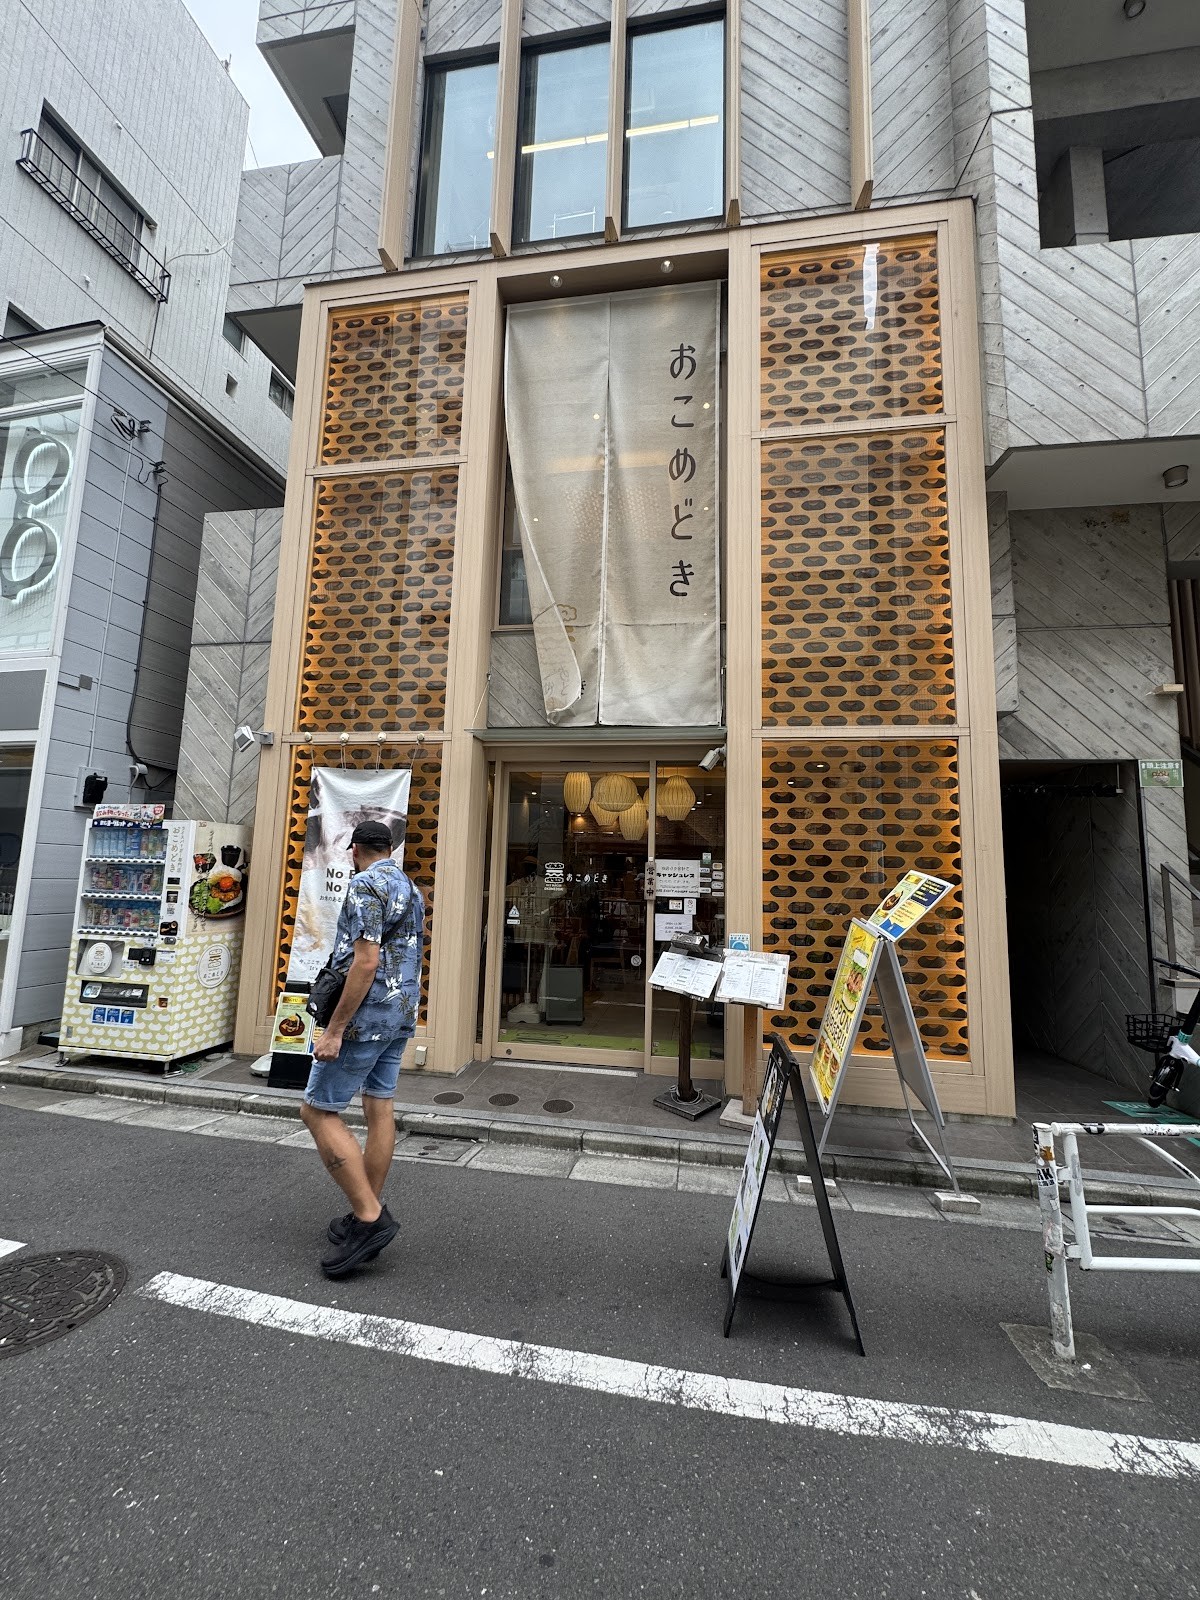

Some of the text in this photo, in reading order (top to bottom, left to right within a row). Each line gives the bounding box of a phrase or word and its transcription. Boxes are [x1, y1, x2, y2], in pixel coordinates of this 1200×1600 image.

[669, 342, 697, 598] おこめどき
[169, 826, 181, 873] おこめどき
[325, 881, 342, 892] No
[326, 868, 344, 879] No
[646, 867, 655, 896] 営業中
